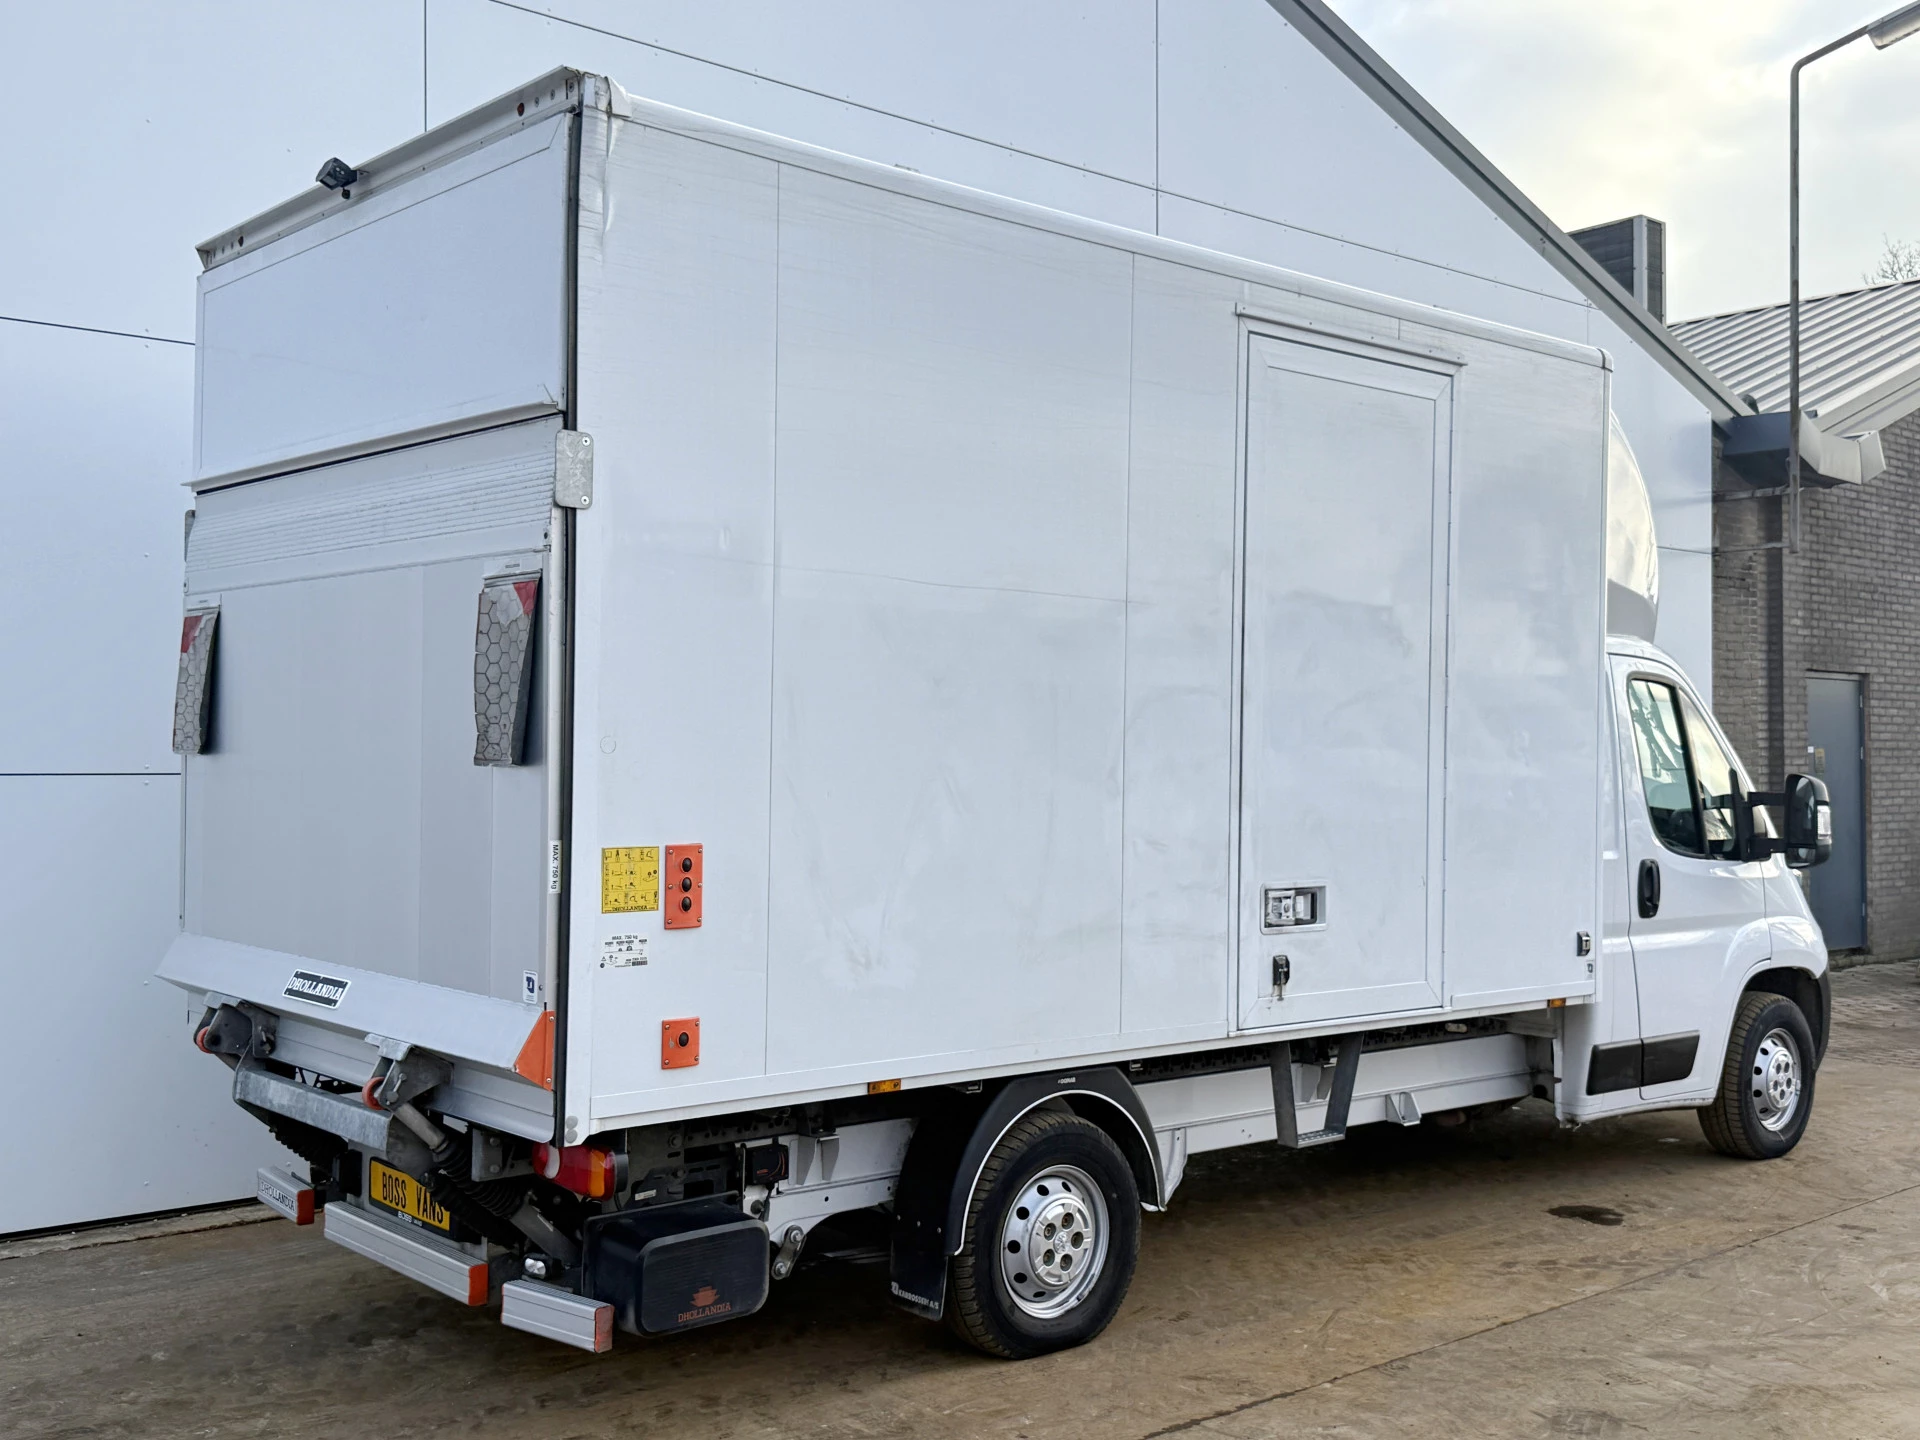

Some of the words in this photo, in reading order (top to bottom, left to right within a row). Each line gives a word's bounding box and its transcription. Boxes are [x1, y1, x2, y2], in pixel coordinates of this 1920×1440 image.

[288, 976, 343, 1000] DHOLLANDIA
[261, 1181, 295, 1211] DHOLLANDIA
[382, 1171, 407, 1209] BOSS
[416, 1184, 444, 1224] VANS
[678, 1302, 732, 1323] DHOLLANDIA
